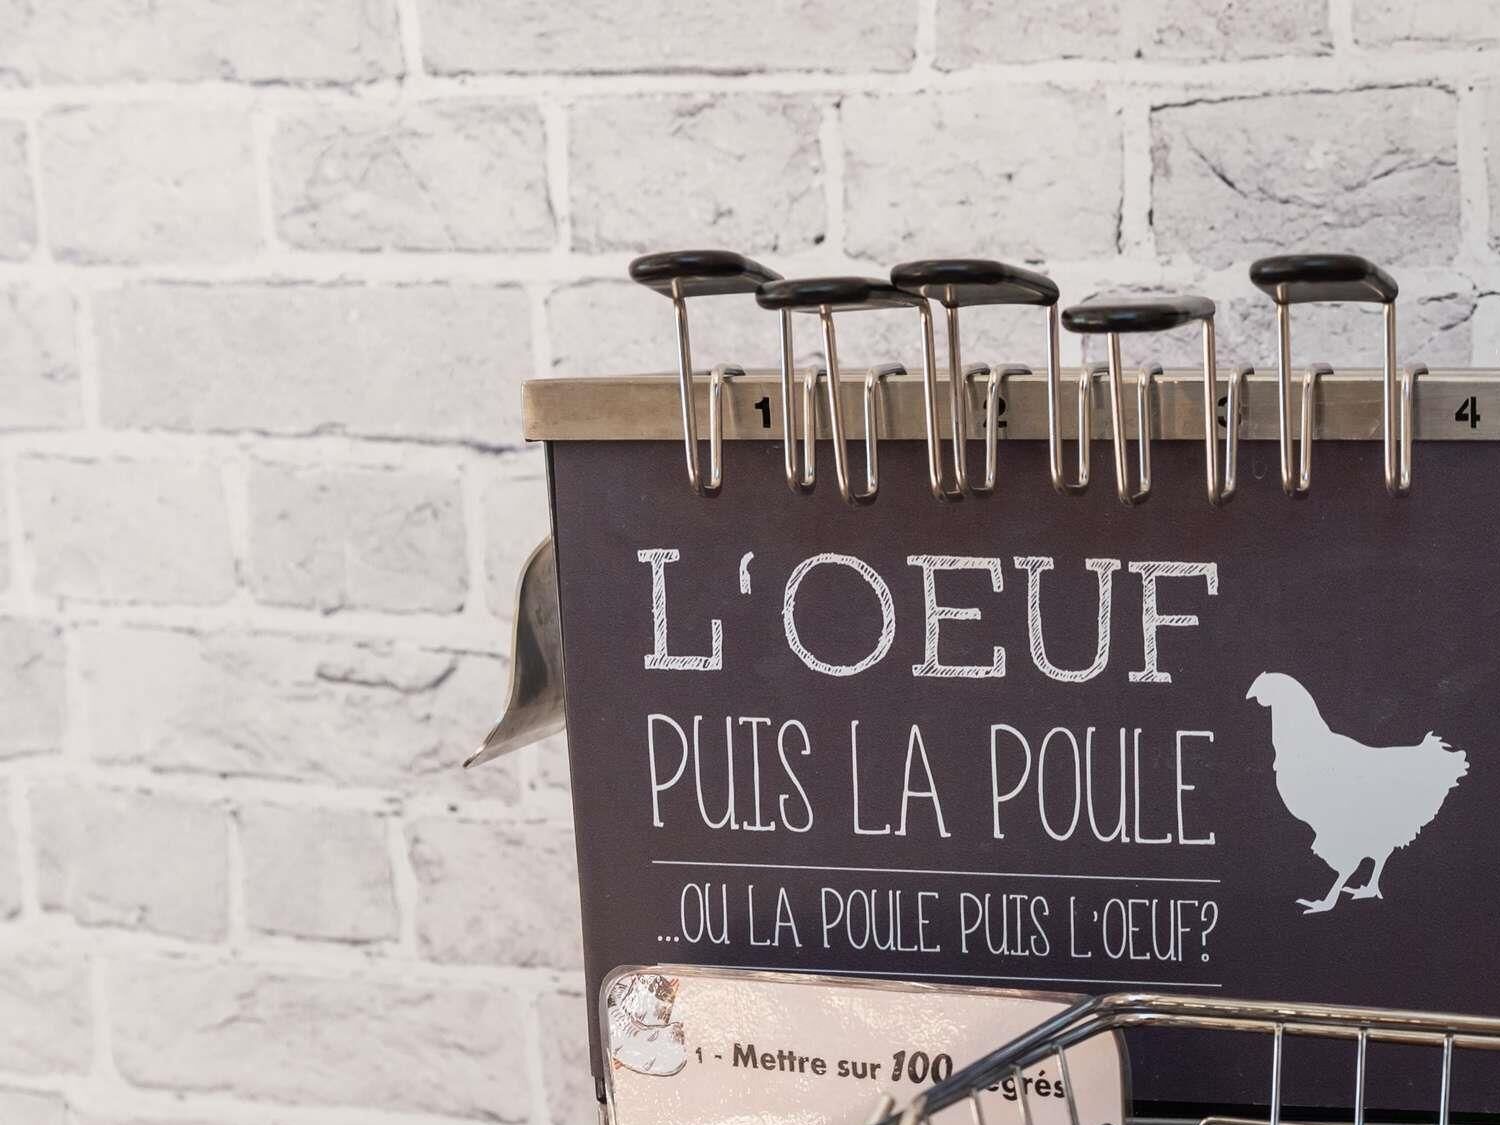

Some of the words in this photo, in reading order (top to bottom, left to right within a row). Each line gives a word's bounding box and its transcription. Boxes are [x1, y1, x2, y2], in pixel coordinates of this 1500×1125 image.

[754, 397, 771, 428] 1
[1454, 396, 1481, 429] 4
[648, 714, 813, 832] PUIS
[851, 720, 951, 837] LA
[991, 724, 1215, 844] POULE
[749, 885, 802, 947] LA
[822, 888, 940, 952] POULE
[961, 893, 1049, 956] PUIS
[1071, 897, 1218, 961] L'OEUF?
[695, 1047, 703, 1064] 1
[733, 1043, 827, 1076] Mettre
[837, 1059, 881, 1080] sur
[891, 1050, 954, 1084] 100
[985, 1070, 1066, 1101] grés
